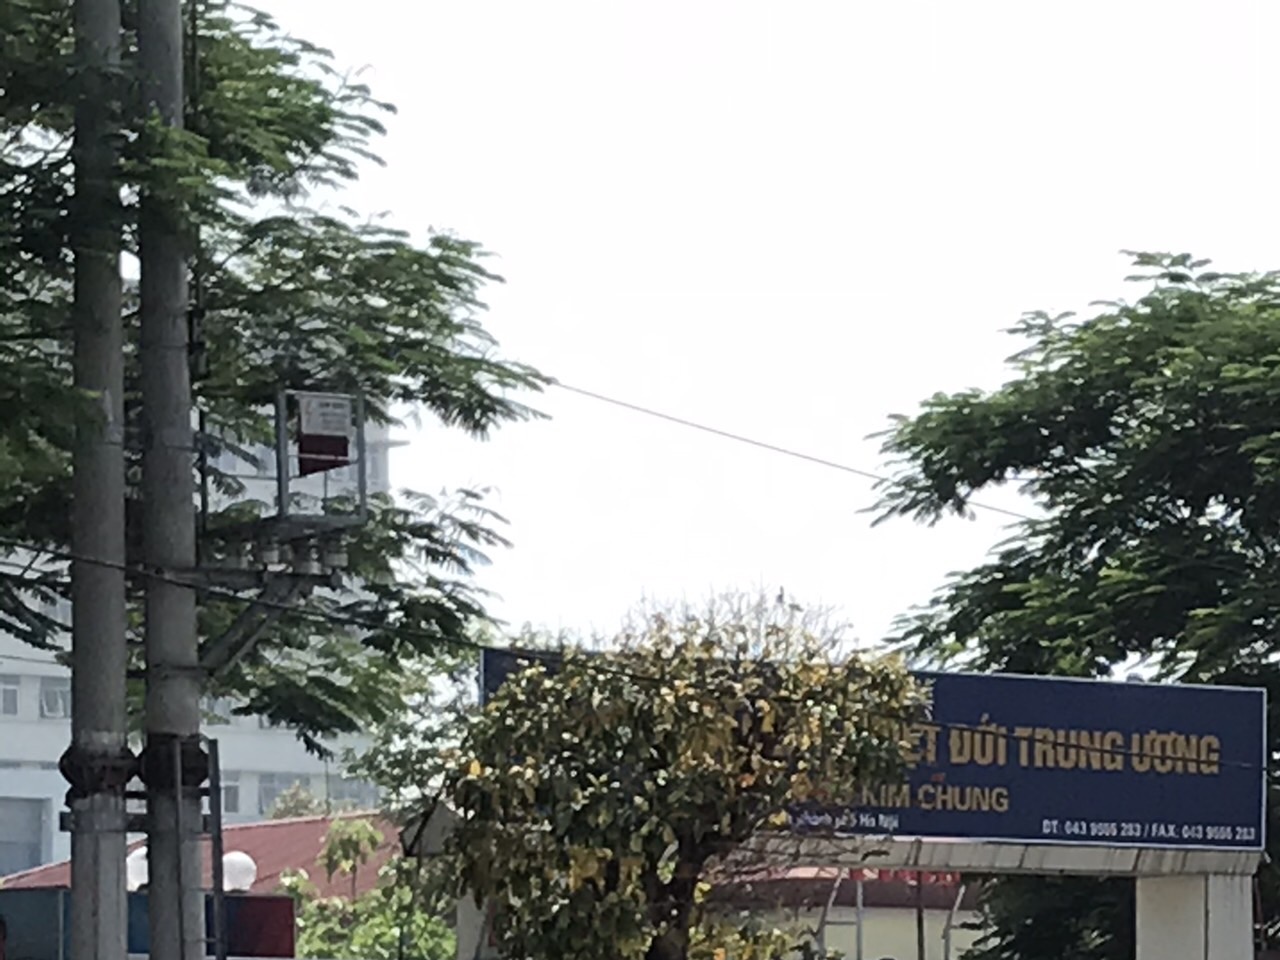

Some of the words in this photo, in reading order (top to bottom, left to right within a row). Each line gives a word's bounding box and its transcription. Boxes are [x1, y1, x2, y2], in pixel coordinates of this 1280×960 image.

[1014, 726, 1124, 771] TRUNG
[1131, 729, 1220, 774] ƯƠNG
[917, 783, 1009, 812] CHUNG
